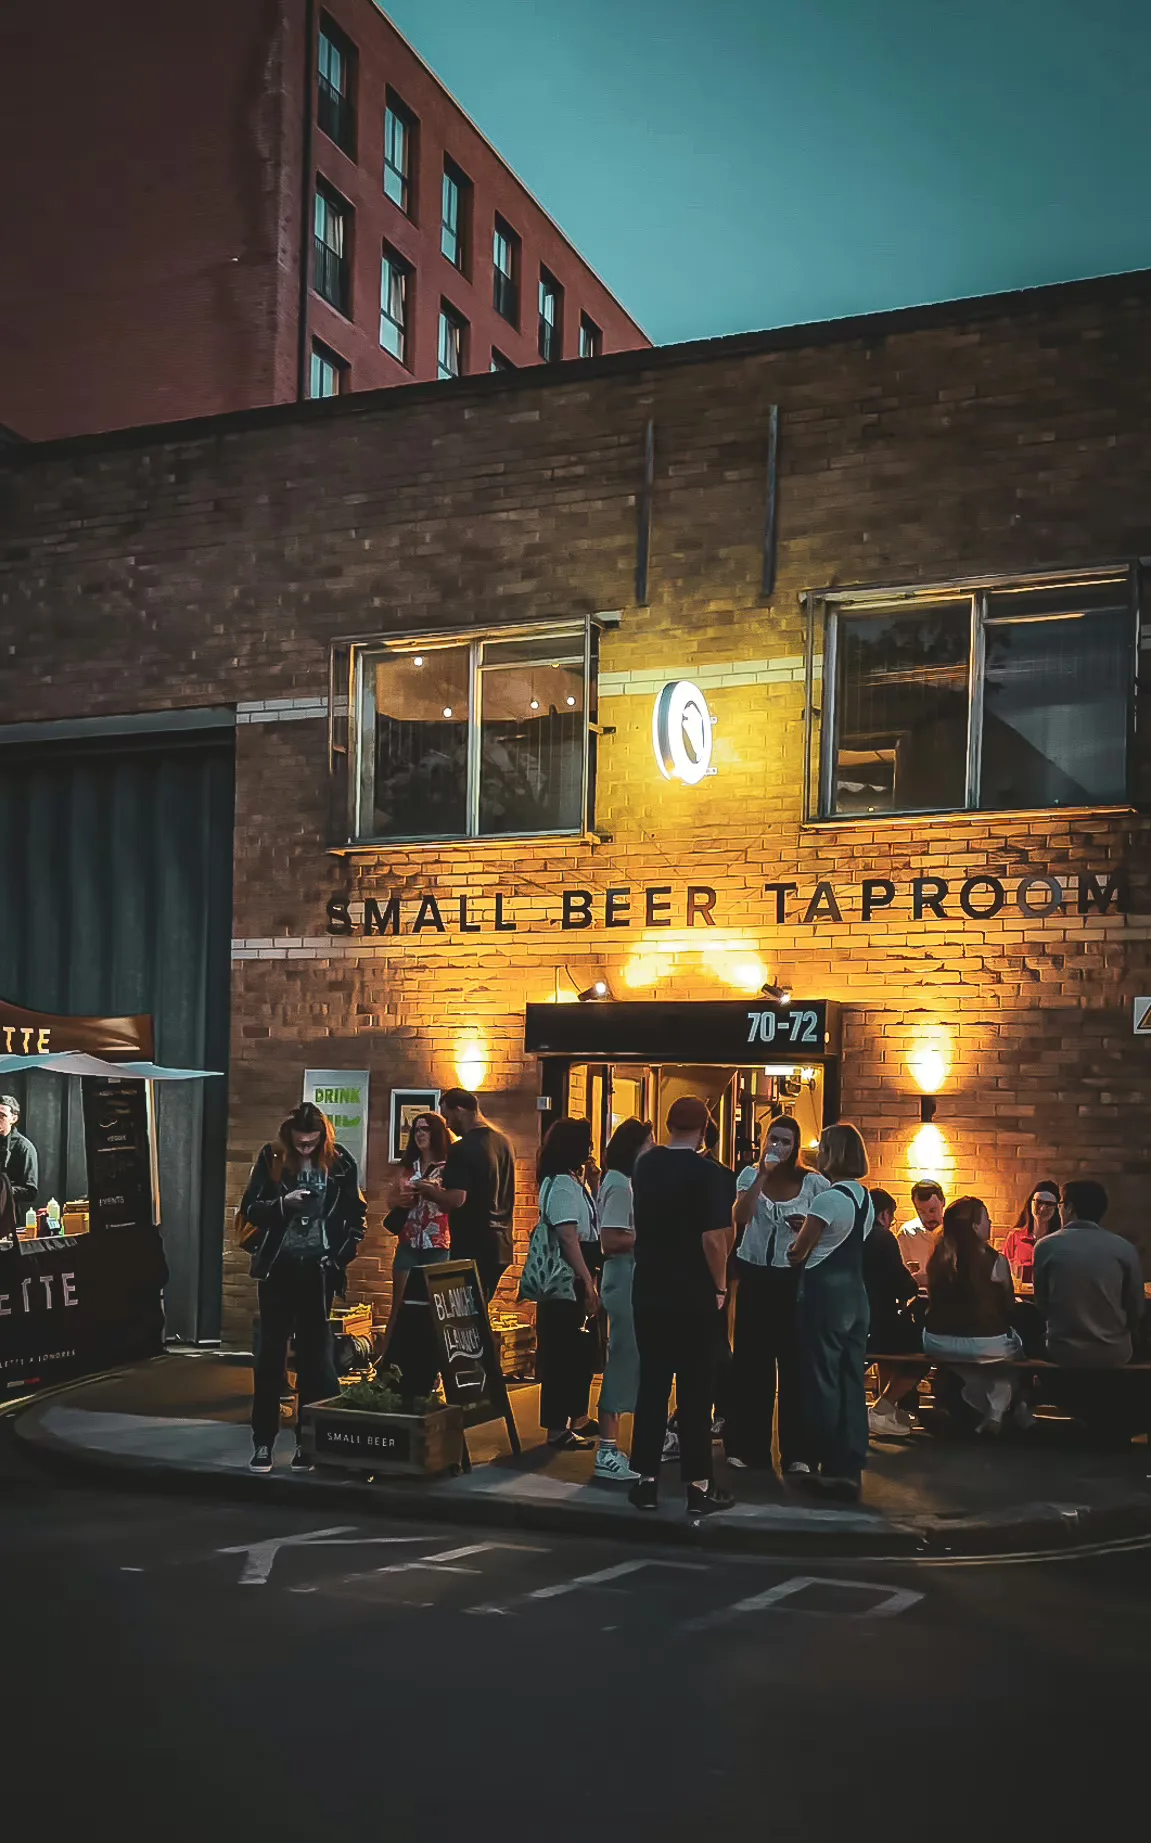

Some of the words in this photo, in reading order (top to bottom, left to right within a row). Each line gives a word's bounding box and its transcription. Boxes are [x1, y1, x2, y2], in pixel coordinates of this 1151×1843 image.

[326, 889, 517, 936] SMALL
[561, 885, 717, 930] BEER
[764, 868, 1130, 924] TAPROOM
[2, 1026, 51, 1054] TTE
[747, 1011, 818, 1043] 70-72
[315, 1088, 361, 1104] DRINK
[327, 1432, 361, 1444] SMALL
[367, 1436, 396, 1447] BEER
